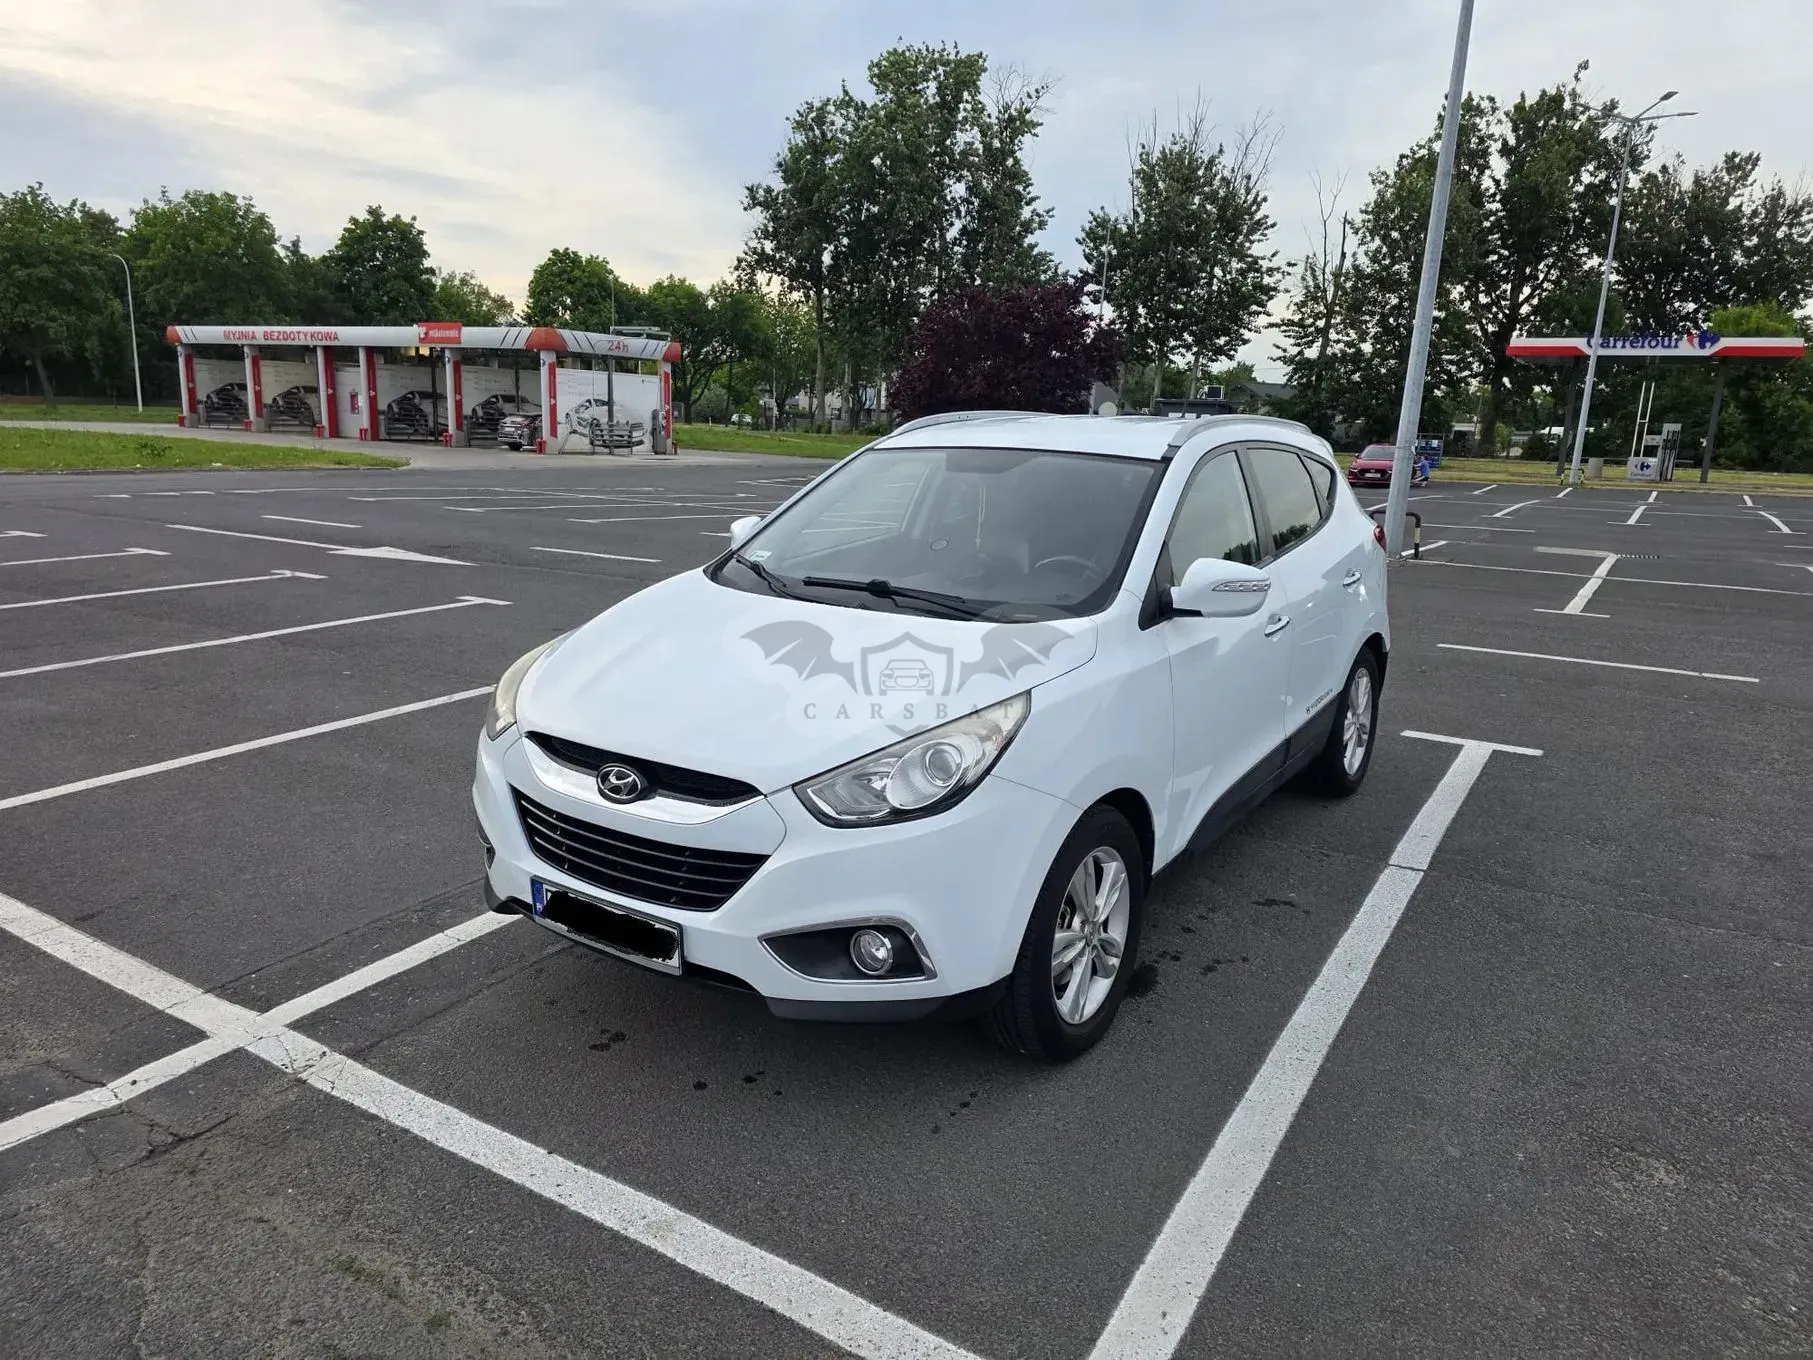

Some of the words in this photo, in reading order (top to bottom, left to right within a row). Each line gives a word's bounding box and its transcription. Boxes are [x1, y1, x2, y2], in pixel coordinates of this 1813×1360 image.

[223, 330, 257, 341] MYJNIA
[263, 330, 340, 341] BEZDOTYKOWA
[608, 339, 629, 352] 24h
